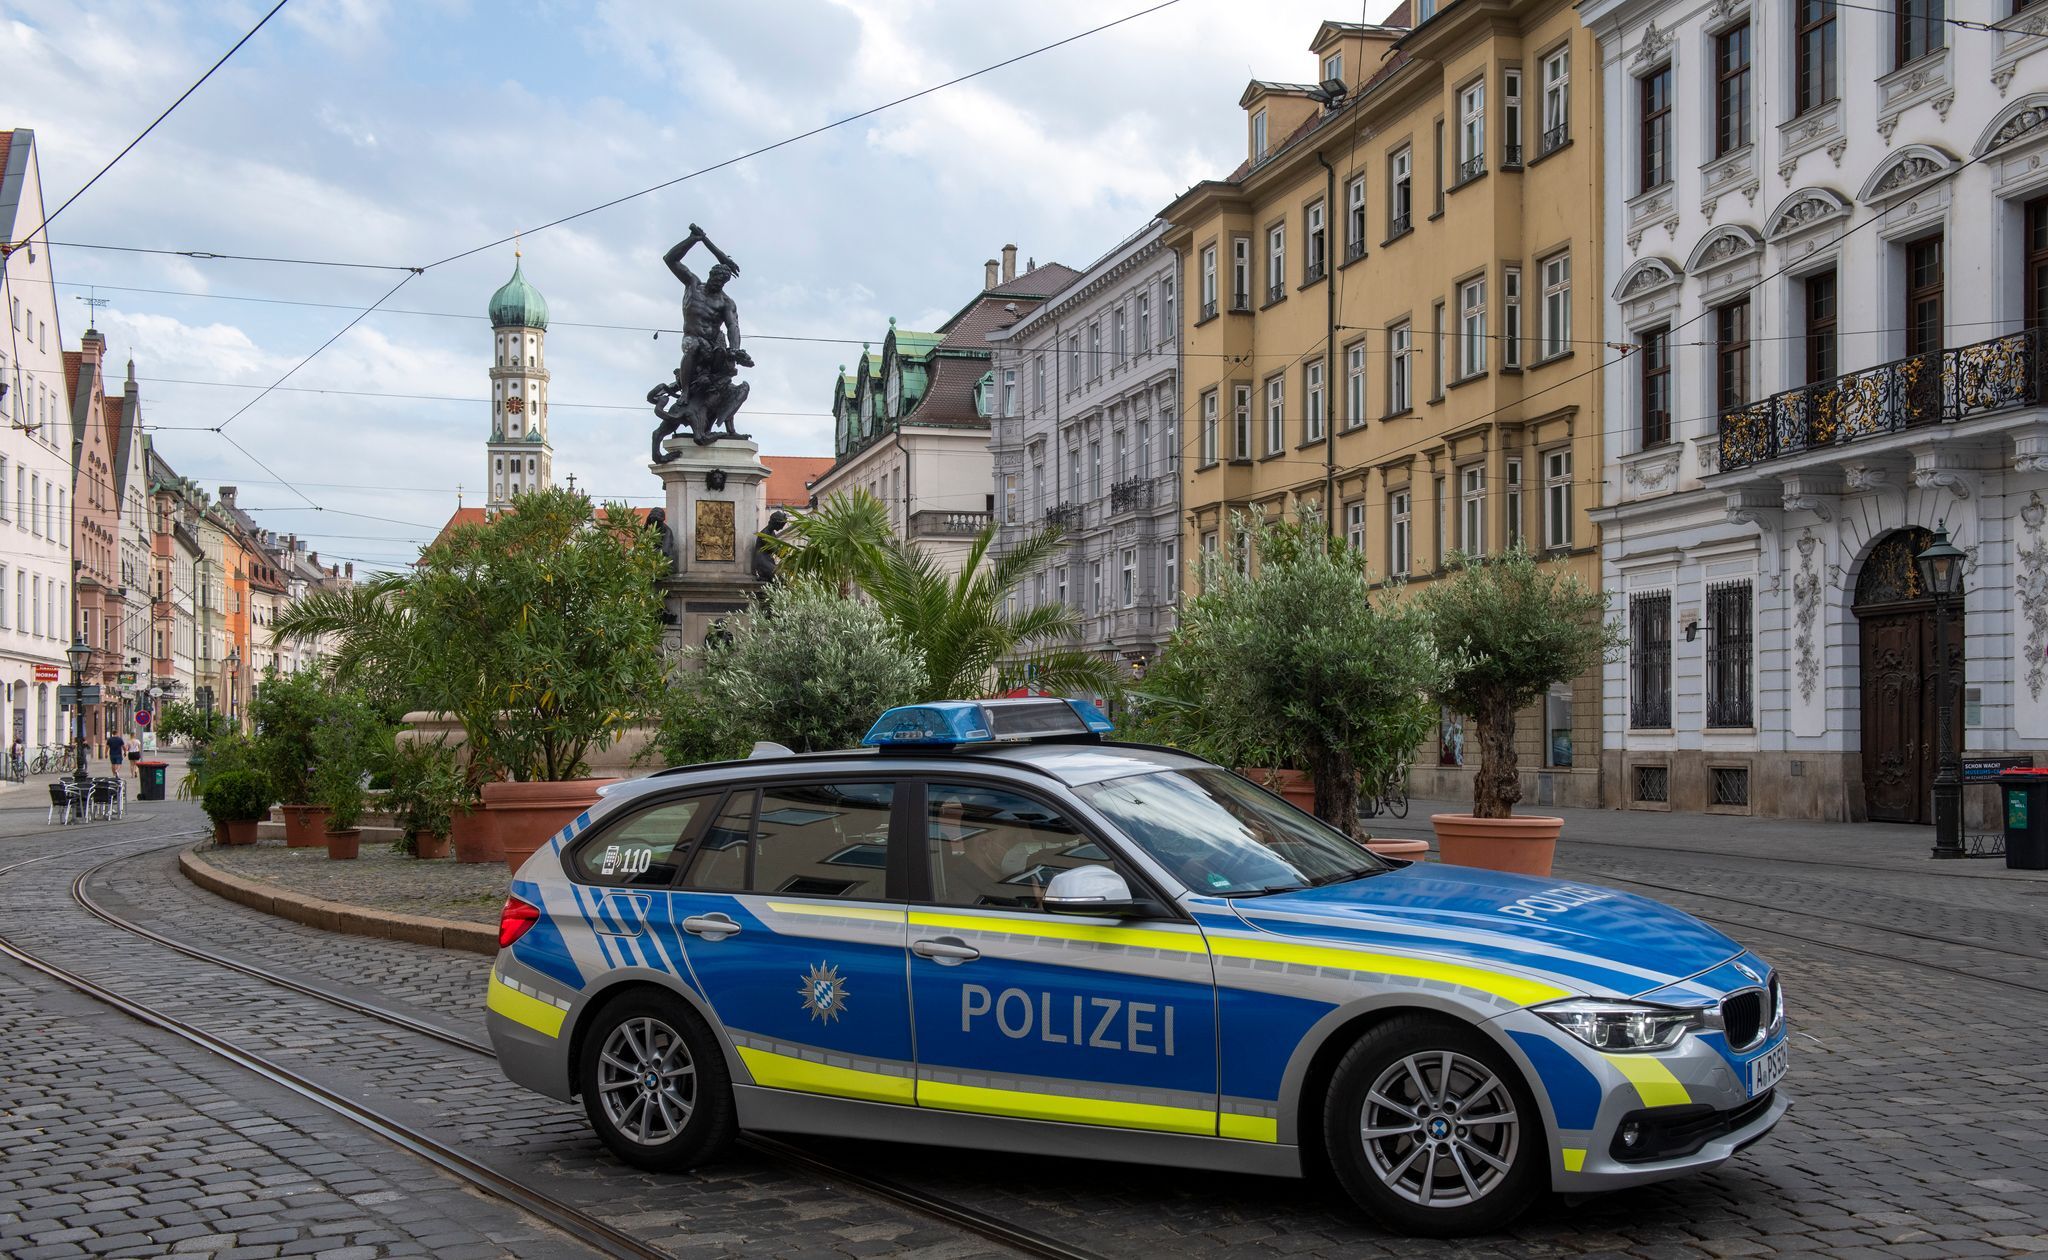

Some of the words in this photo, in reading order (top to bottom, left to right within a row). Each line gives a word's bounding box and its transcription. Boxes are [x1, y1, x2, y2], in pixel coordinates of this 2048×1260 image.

[620, 848, 652, 873] 110
[1497, 886, 1616, 921] POLIZEI
[961, 983, 1175, 1056] POLIZEI
[1757, 1061, 1762, 1088] A
